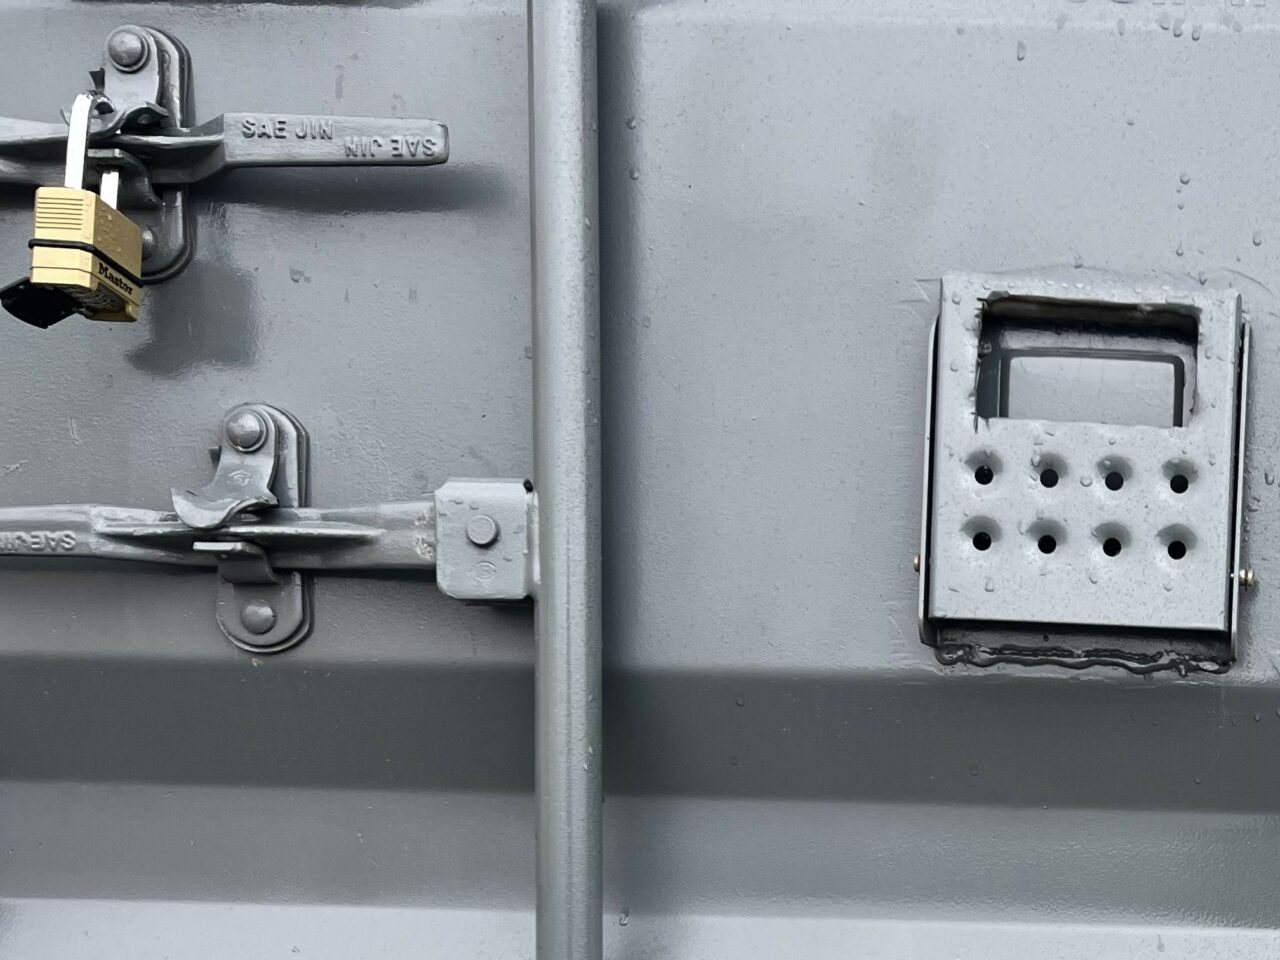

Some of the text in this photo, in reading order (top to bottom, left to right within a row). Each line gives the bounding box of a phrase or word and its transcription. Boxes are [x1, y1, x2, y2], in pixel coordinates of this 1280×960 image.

[241, 119, 333, 140] SAE JIN
[344, 135, 437, 157] SAE JIN
[98, 261, 134, 295] Master
[30, 531, 76, 551] SAE
